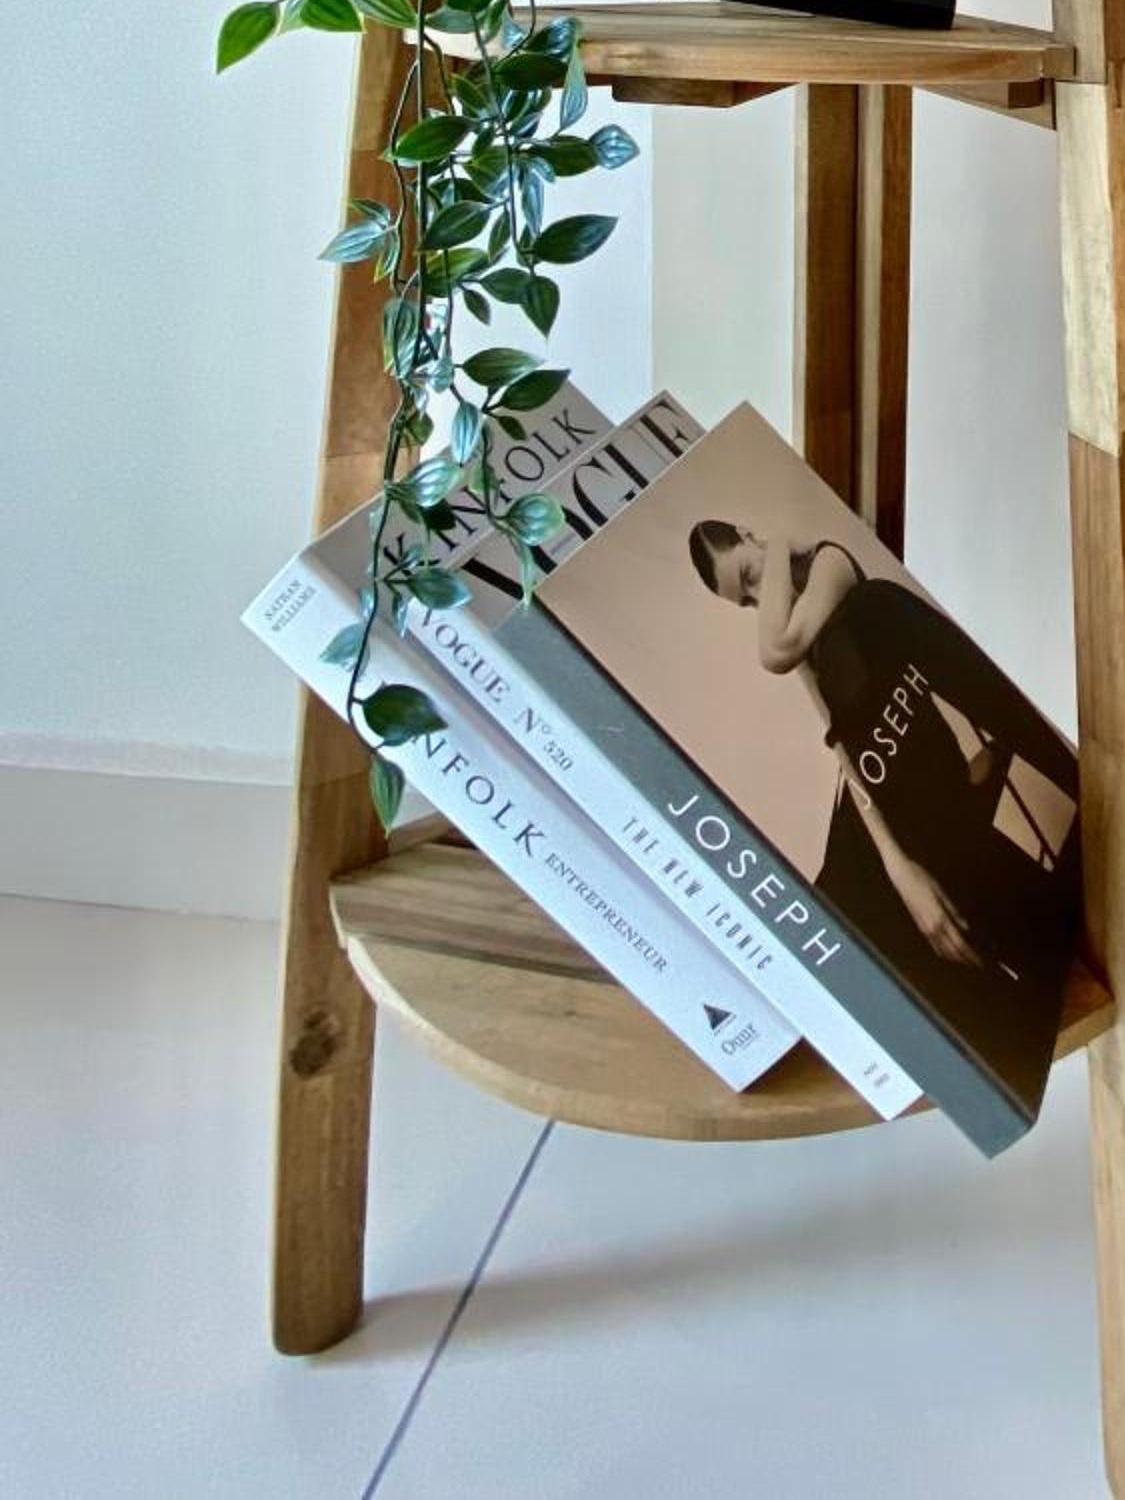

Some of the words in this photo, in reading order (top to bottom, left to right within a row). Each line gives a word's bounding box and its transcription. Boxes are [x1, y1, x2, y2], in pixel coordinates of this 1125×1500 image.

[422, 609, 511, 703] VOGUE
[544, 851, 669, 973] ENTREPRENEUR
[623, 817, 660, 853] THE
[663, 858, 704, 899] NEW
[705, 902, 773, 970] ICONIC
[667, 795, 842, 966] JOSEPH
